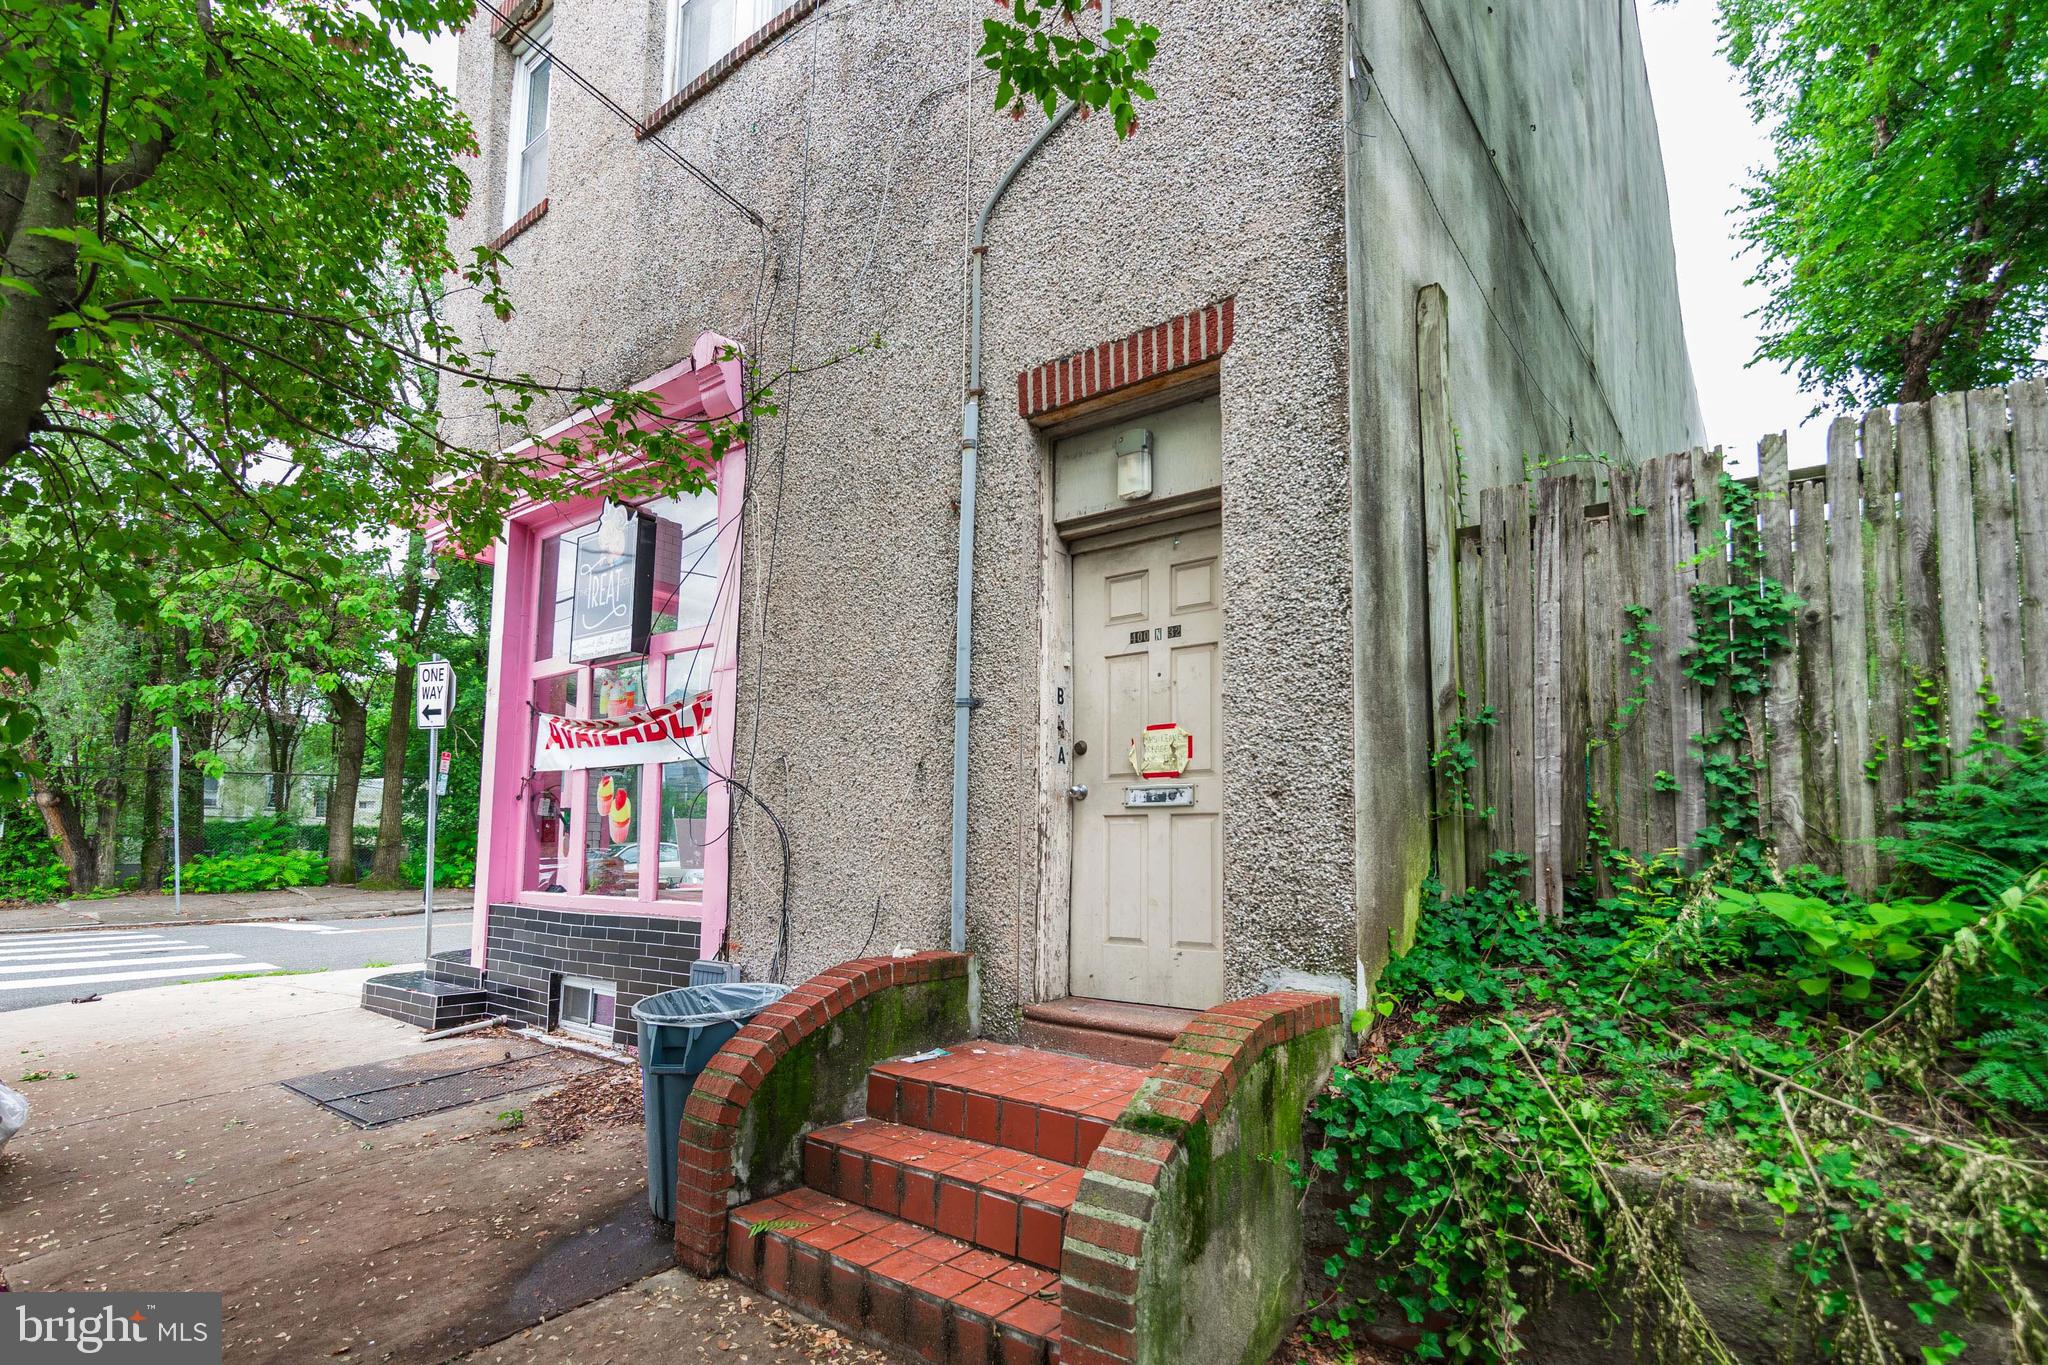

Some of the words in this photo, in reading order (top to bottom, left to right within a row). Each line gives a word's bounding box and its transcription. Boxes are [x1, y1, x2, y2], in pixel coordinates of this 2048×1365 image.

[581, 559, 625, 614] TREAT
[1130, 629, 1150, 644] 400
[1155, 628, 1162, 640] N
[1167, 625, 1181, 638] 32
[422, 667, 444, 683] ONE
[421, 685, 444, 700] WAY
[1057, 687, 1065, 705] B
[545, 691, 713, 749] AVAILABLE
[1057, 746, 1066, 764] A
